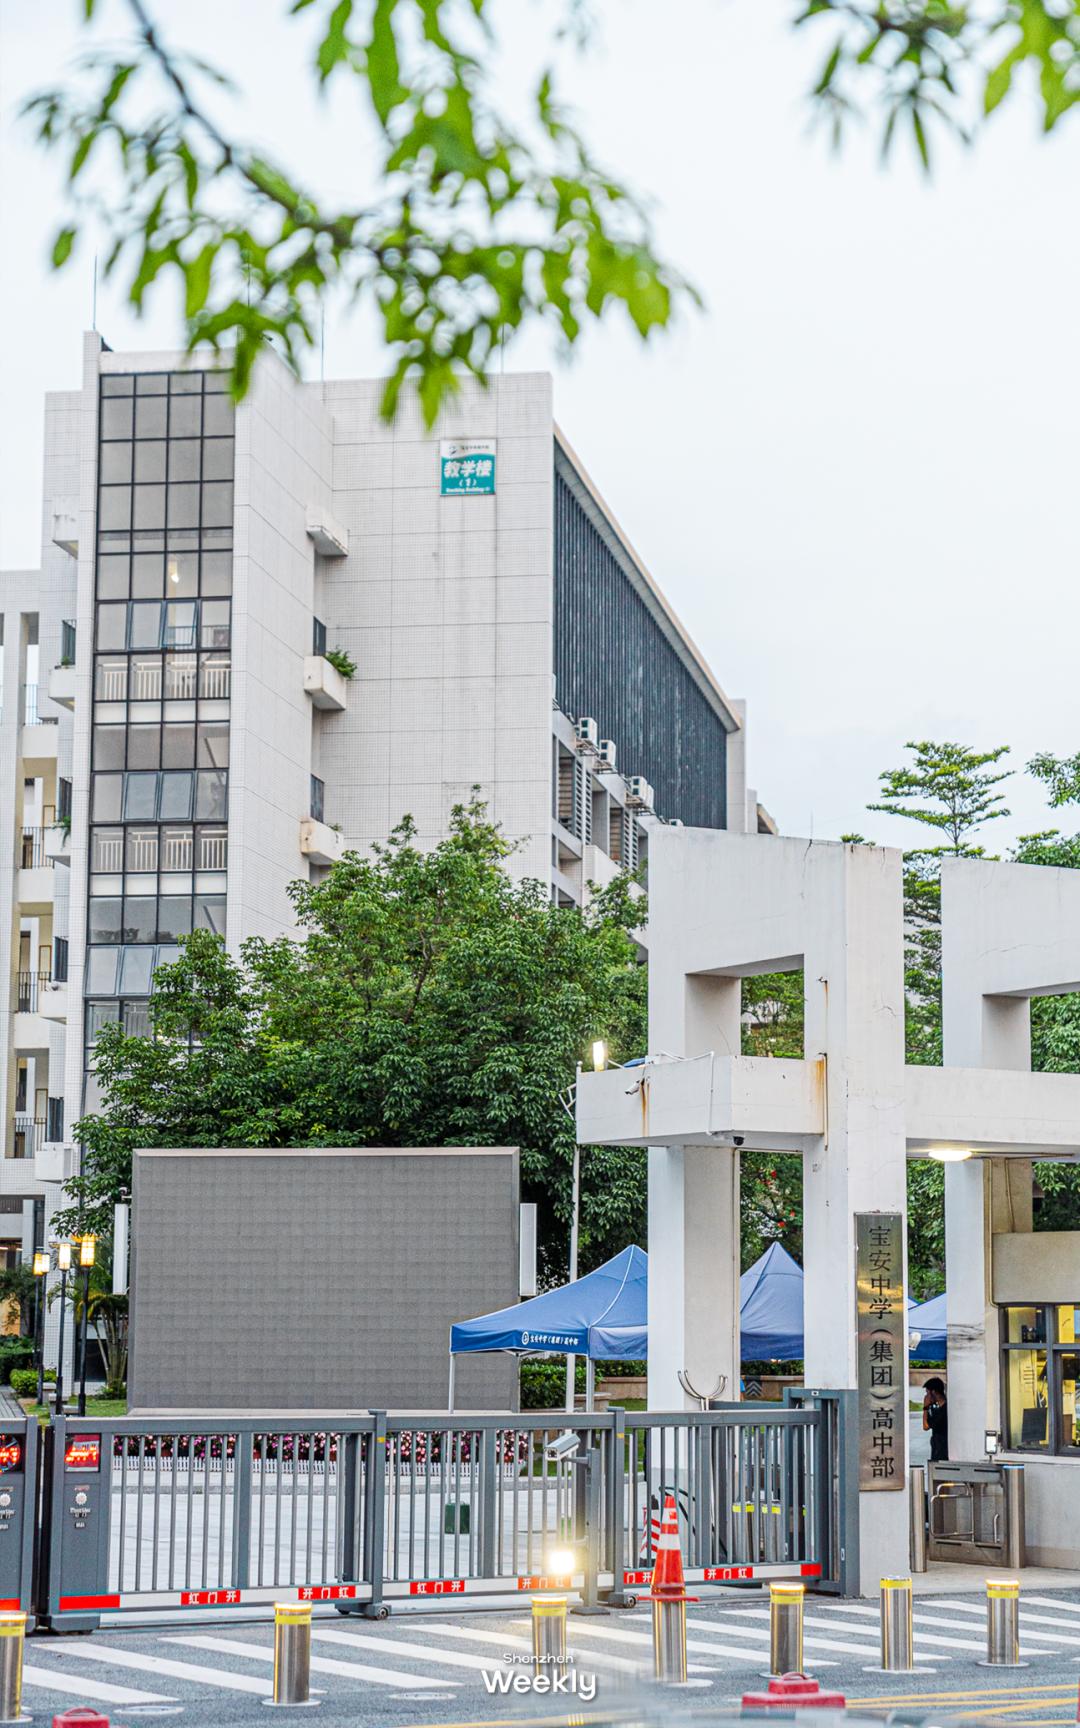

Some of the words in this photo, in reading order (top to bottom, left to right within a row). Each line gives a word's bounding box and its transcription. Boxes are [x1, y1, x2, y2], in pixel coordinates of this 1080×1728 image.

[869, 1226, 895, 1479] 宝安中学（集团）高中部
[627, 1571, 652, 1584] 门开
[707, 1567, 747, 1580] 开门红
[303, 1587, 349, 1599] 开门红
[416, 1581, 465, 1594] 红门开
[188, 1591, 237, 1604] 红门开
